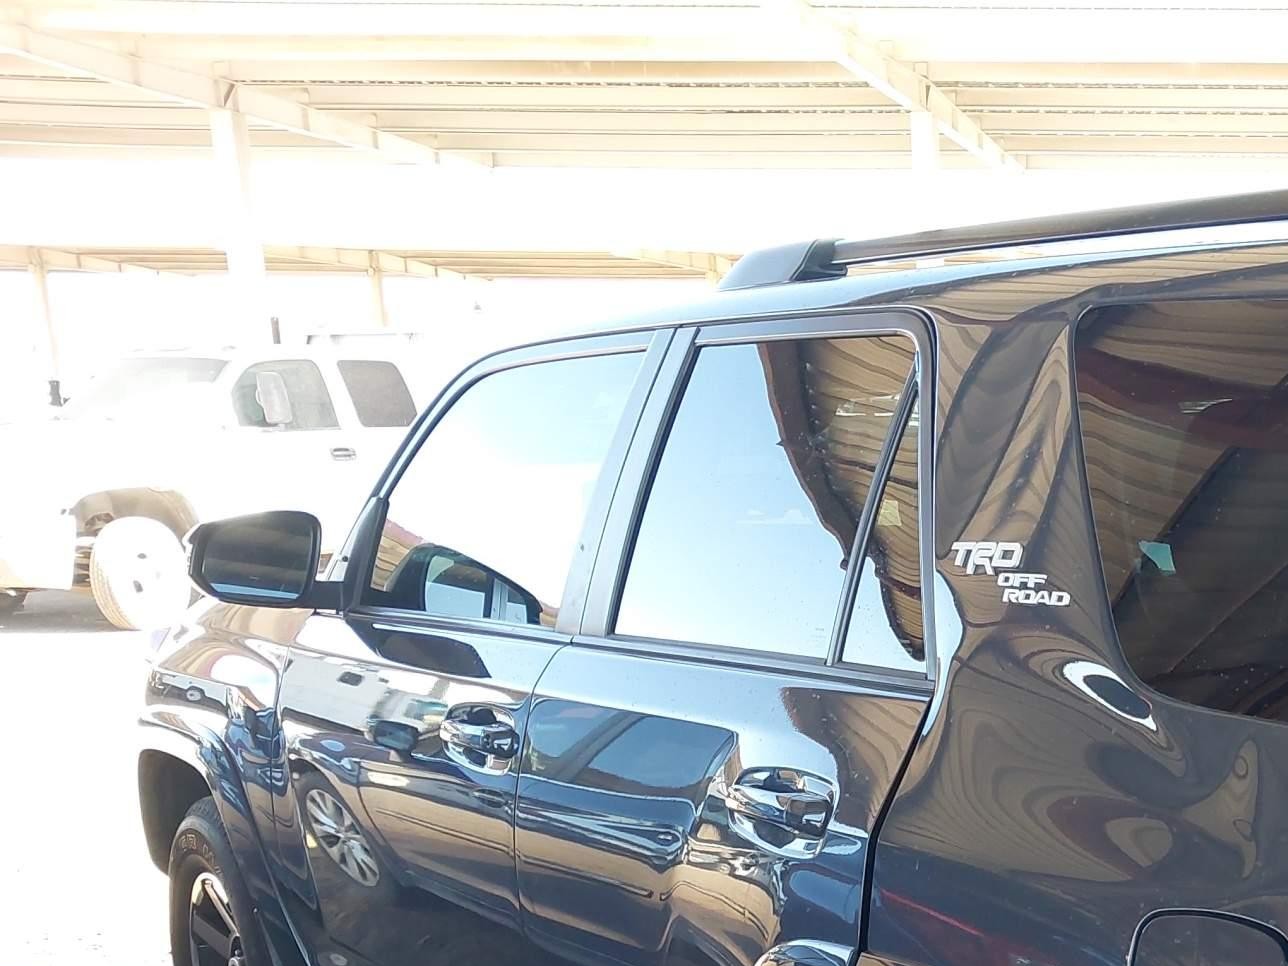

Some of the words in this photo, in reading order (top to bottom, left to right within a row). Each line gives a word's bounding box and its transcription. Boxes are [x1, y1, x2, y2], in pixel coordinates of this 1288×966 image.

[951, 541, 1024, 575] TRD
[997, 572, 1048, 588] OFF
[1002, 588, 1071, 607] ROAD
